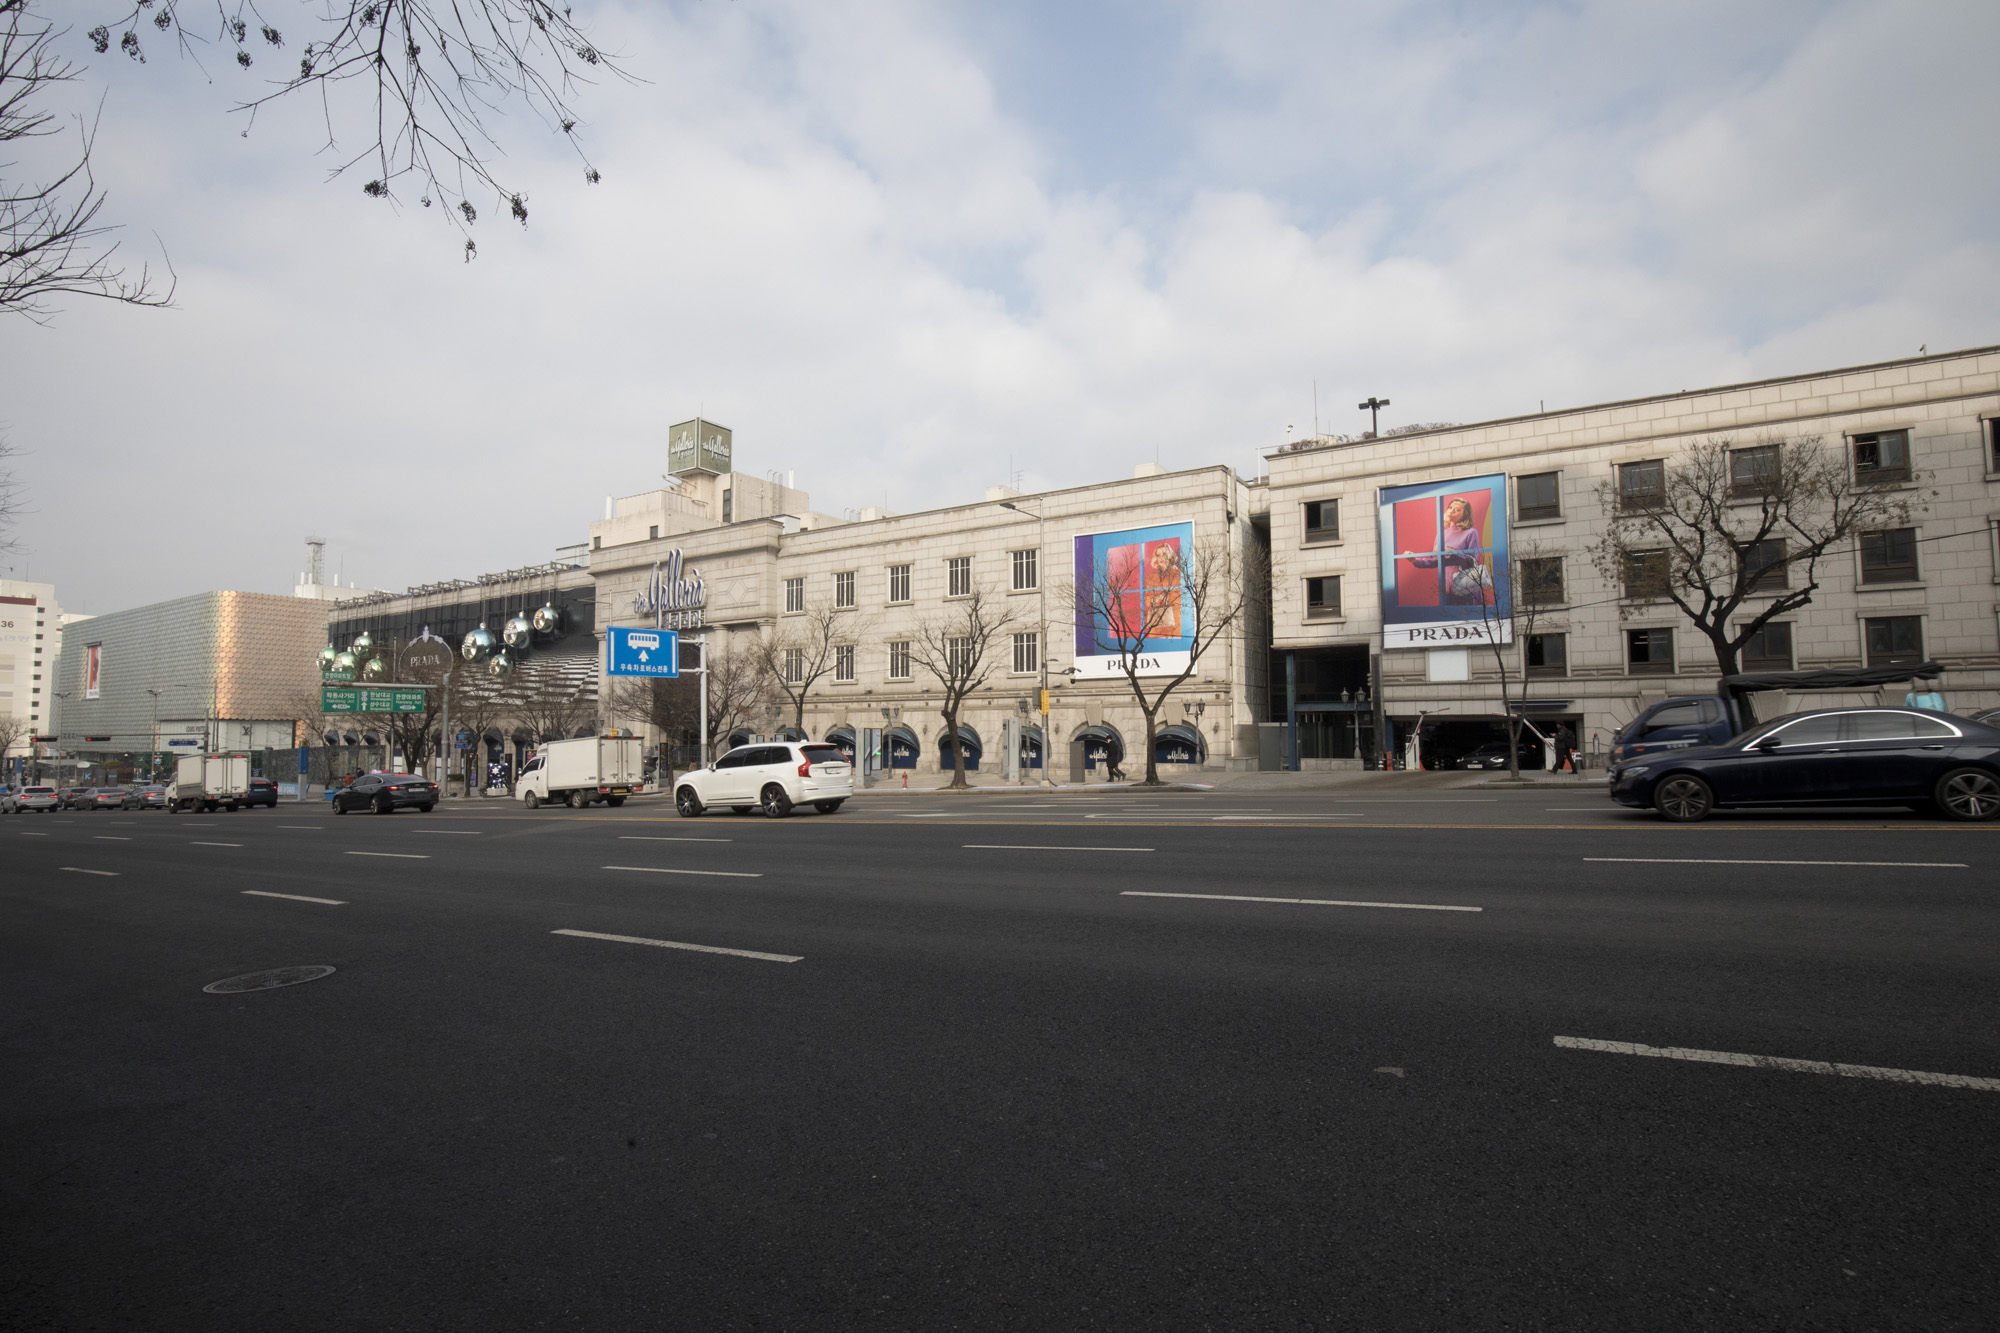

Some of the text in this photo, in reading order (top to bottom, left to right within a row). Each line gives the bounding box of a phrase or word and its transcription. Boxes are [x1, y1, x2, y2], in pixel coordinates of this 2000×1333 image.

[632, 548, 707, 630] the Galleria
[1408, 626, 1484, 641] PRADA
[410, 655, 440, 667] PRADA
[620, 663, 668, 673] 우측차로버스전용
